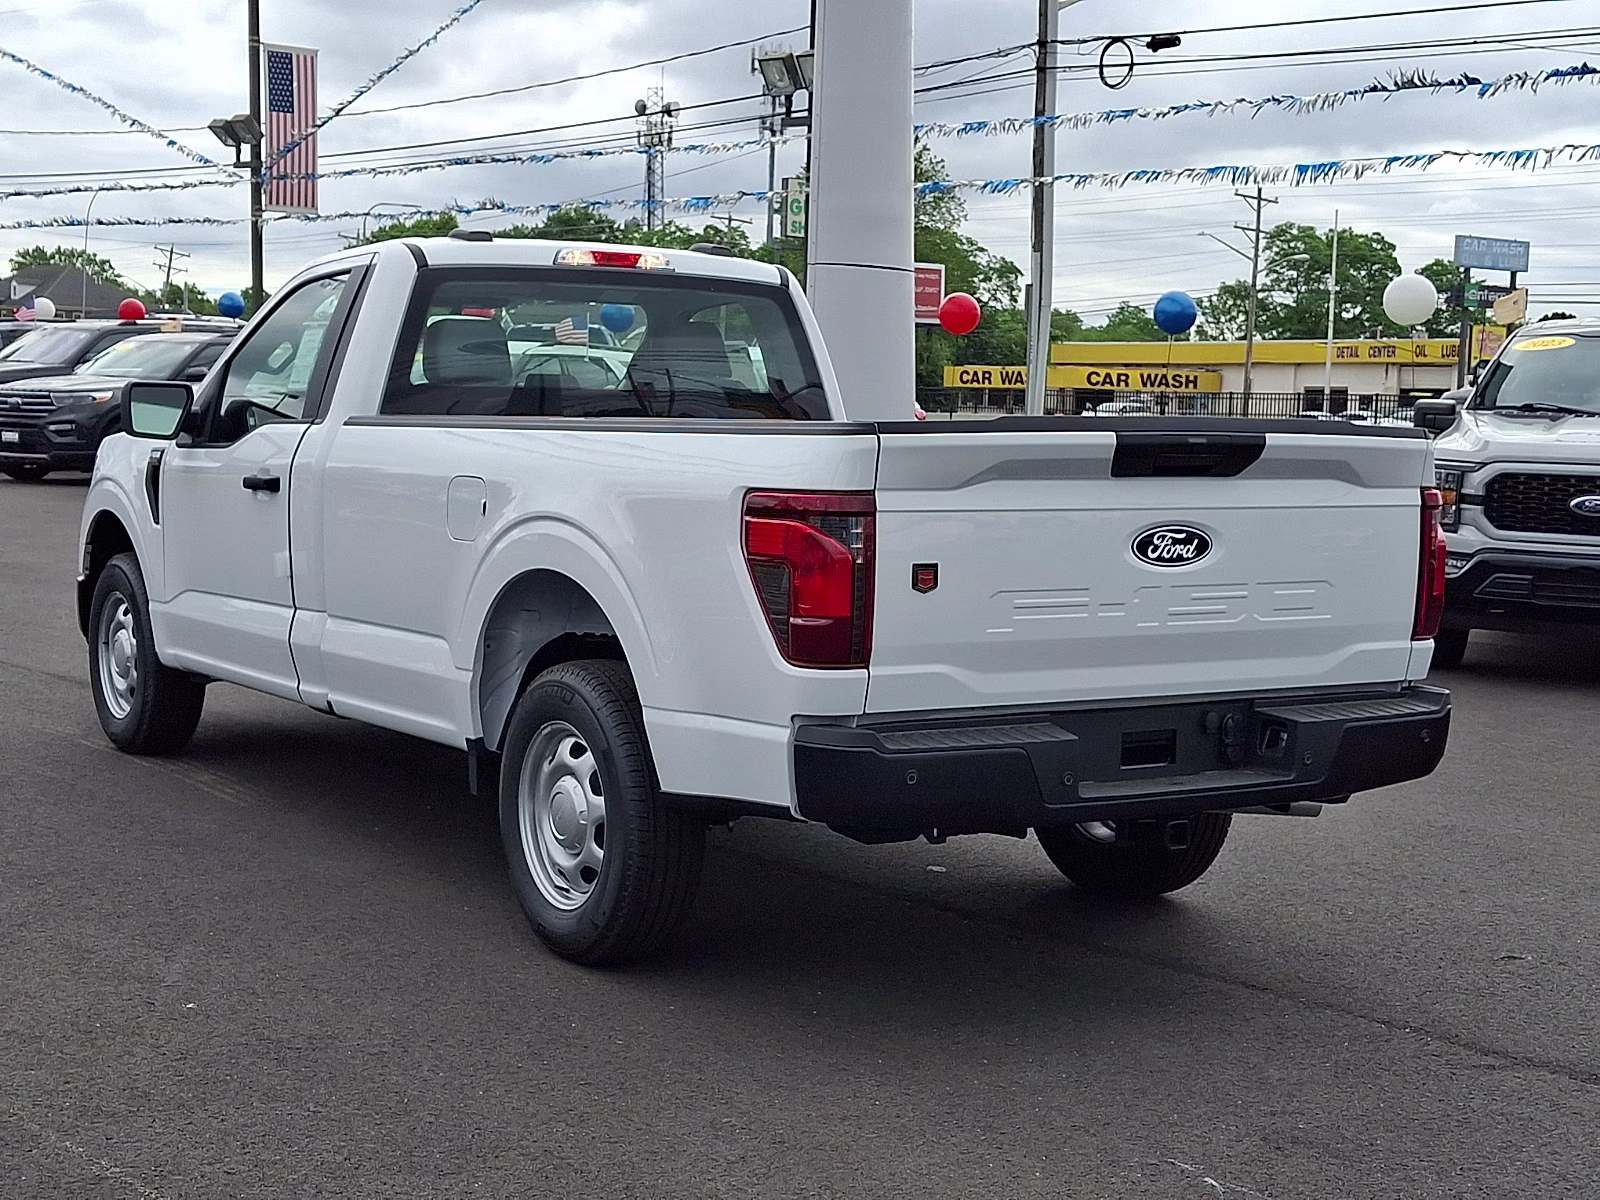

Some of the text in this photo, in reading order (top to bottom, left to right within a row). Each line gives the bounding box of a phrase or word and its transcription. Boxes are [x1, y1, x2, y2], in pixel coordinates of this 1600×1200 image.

[1463, 238, 1525, 255] CAR WASH
[1336, 345, 1360, 359] DETAIL
[1368, 345, 1397, 359] CENTER
[1414, 345, 1428, 358] OIL
[959, 369, 1027, 386] CAR WA
[1086, 371, 1199, 390] CAR WASH
[1147, 531, 1199, 559] Ford
